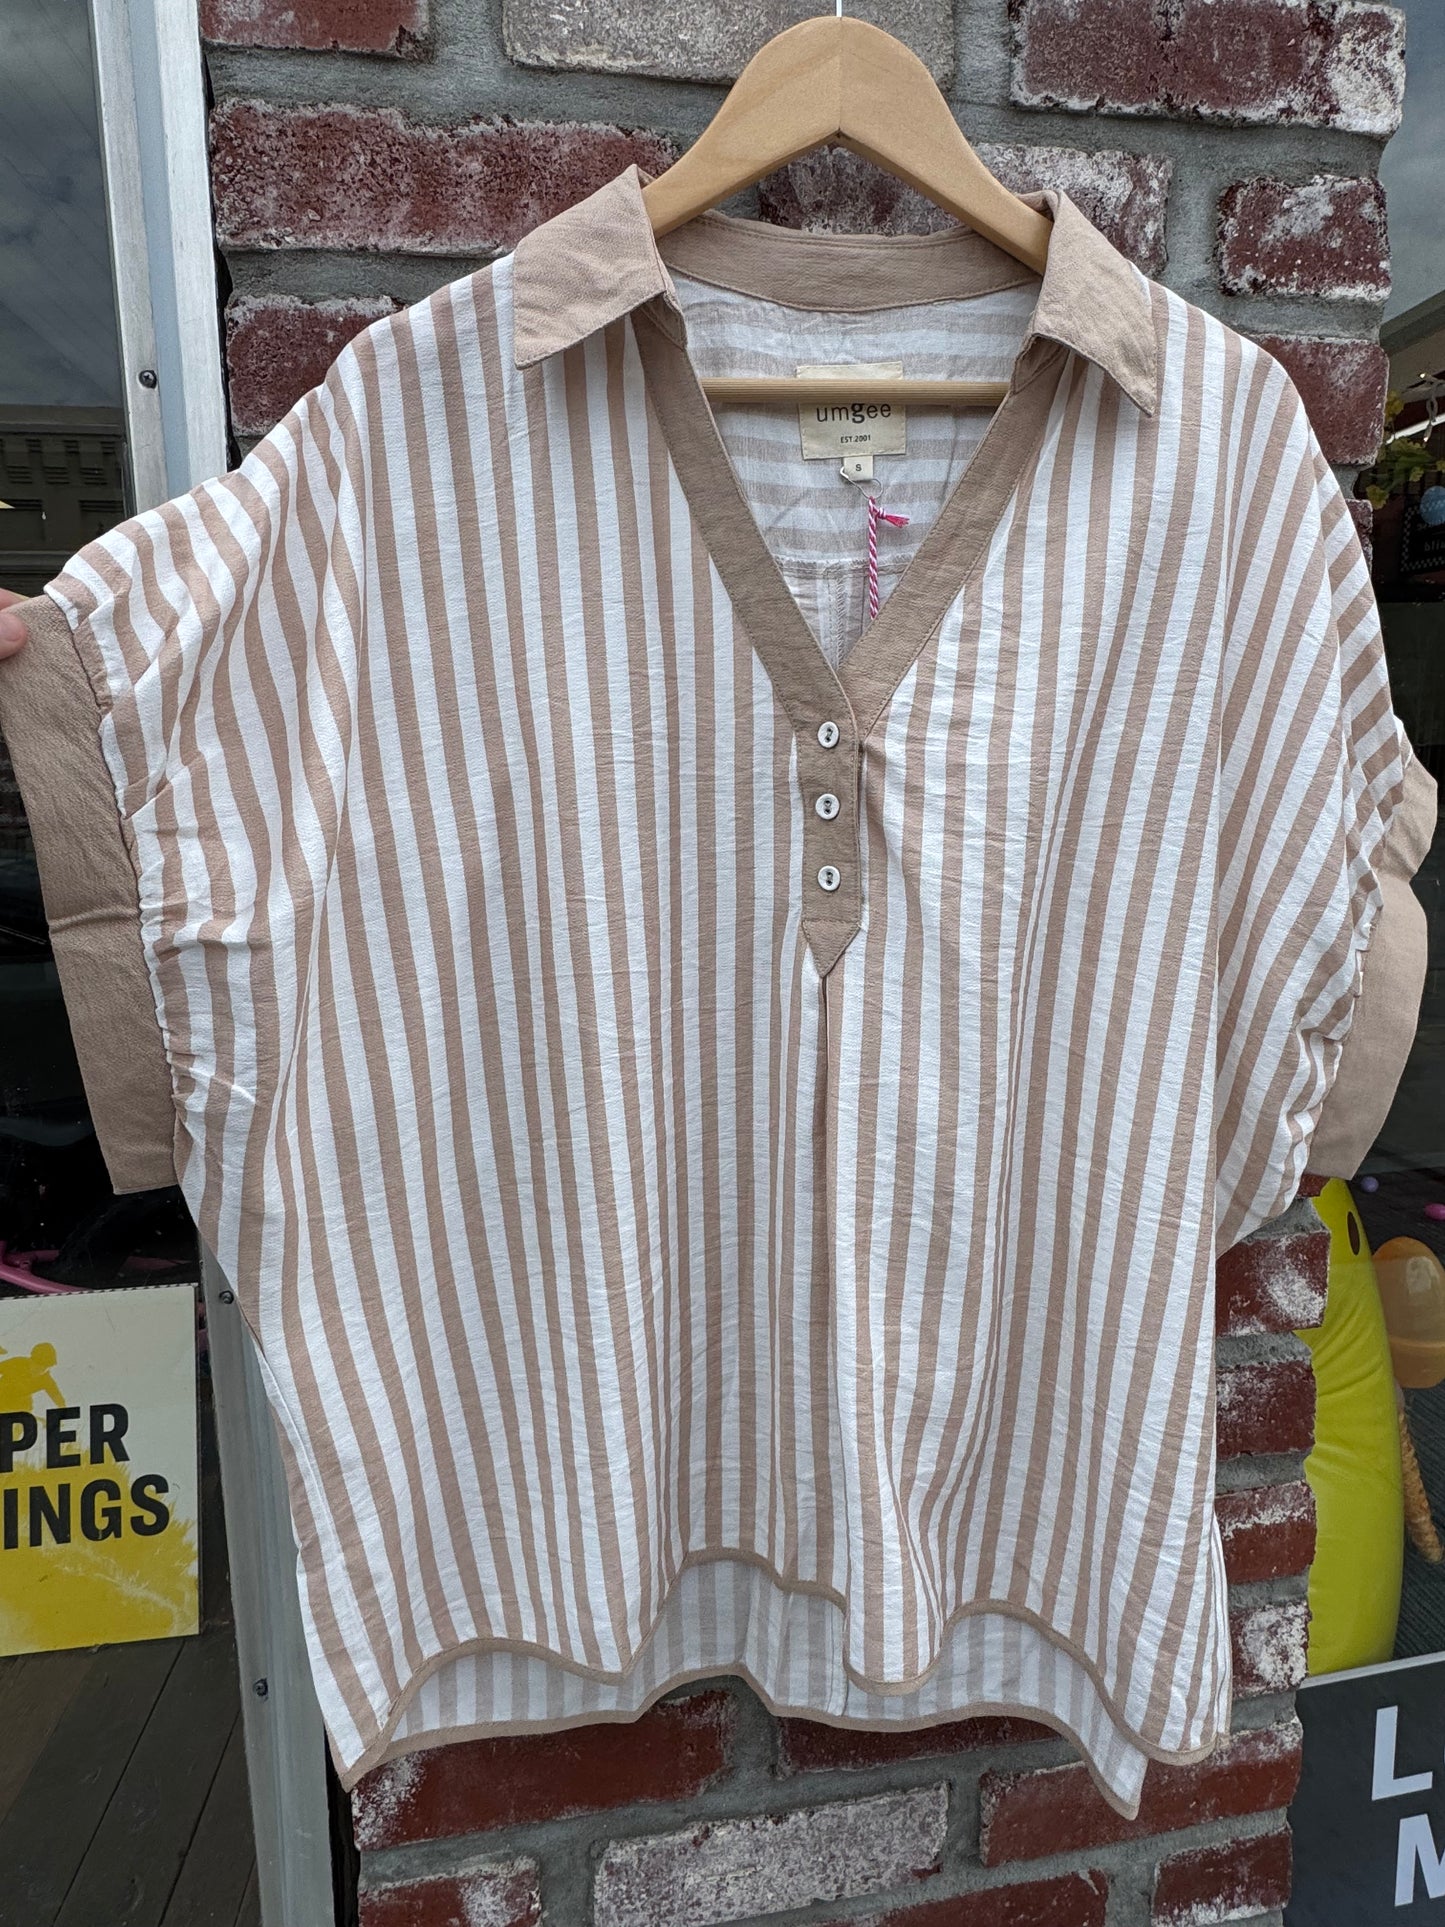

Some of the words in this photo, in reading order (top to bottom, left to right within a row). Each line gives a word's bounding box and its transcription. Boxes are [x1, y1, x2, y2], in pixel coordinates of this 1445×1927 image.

[816, 403, 891, 424] umgee
[855, 463, 863, 472] S
[0, 1403, 130, 1473] PER
[4, 1474, 170, 1549] INGS
[1372, 1705, 1445, 1801] L
